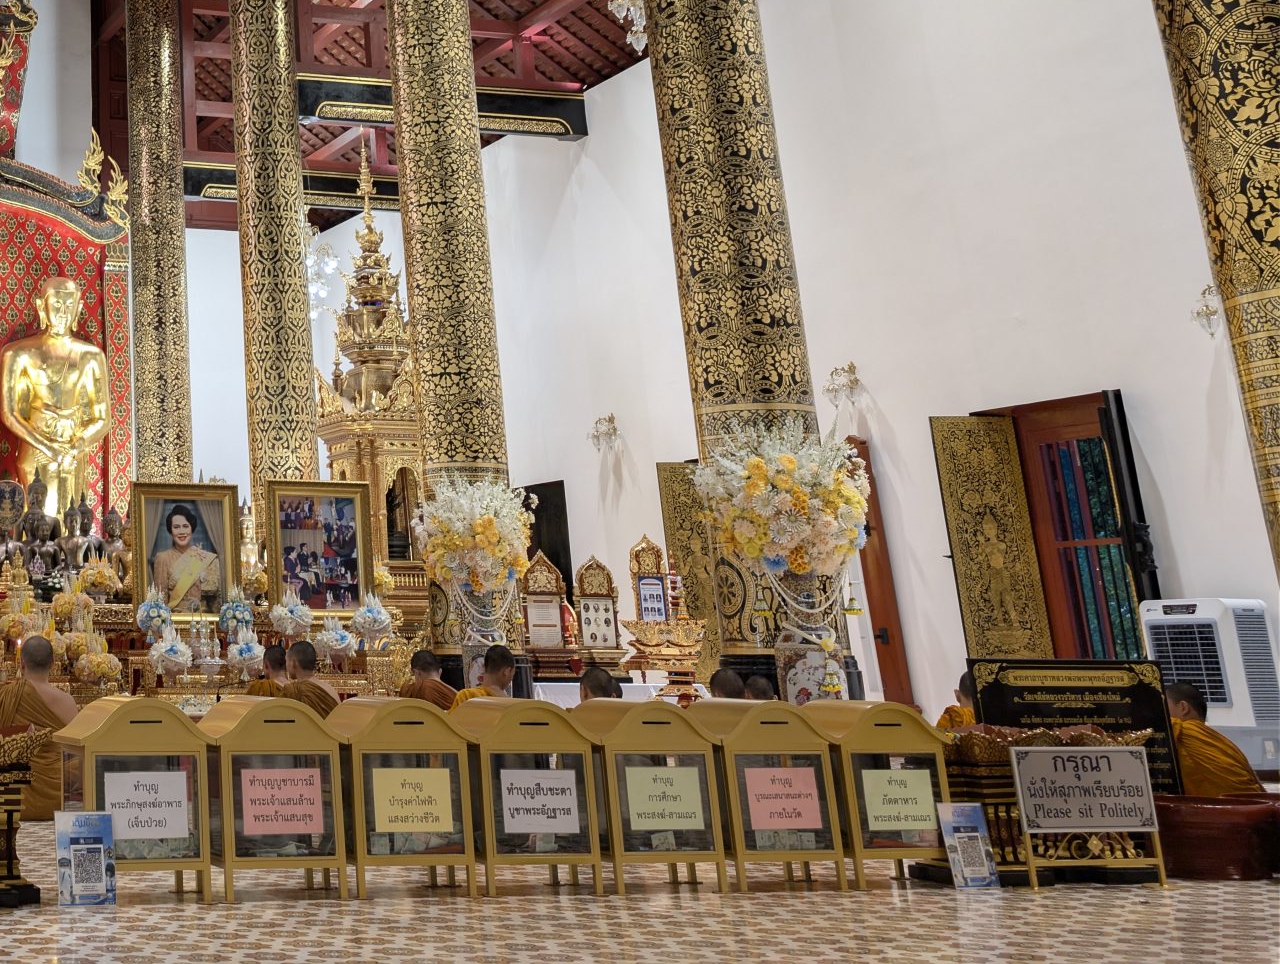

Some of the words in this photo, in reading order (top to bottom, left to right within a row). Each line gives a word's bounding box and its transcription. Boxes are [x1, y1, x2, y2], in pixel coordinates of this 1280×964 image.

[1051, 754, 1113, 781] กรุณา
[133, 780, 159, 794] ทำบุญ
[249, 774, 315, 790] ทำบุญบูชาบารมี
[400, 778, 424, 792] ทำบุญ
[652, 774, 674, 787] ทำบุญ
[770, 775, 793, 788] ทำบุญ
[886, 776, 908, 788] ทำบุญ
[506, 782, 572, 800] ทำบุญสืบชะตา
[648, 791, 682, 802] การศึกษา
[1026, 777, 1144, 804] นั่งให้สุภาพเรียบร้อย
[110, 797, 182, 812] พระภิกษุสงฆ์อาพาธ
[250, 793, 315, 806] พระเจ้าแสนล้าน
[388, 795, 437, 809] บำรุงค่าไฟฟ้า
[253, 810, 314, 826] พระเจ้าแสนสุข
[388, 811, 440, 823] แสงสว่างชีวิต
[508, 803, 571, 819] บูชาพระอัฏฐารส
[769, 807, 803, 819] ภายในวัด
[1033, 804, 1072, 819] Please
[1078, 804, 1093, 818] sit
[1100, 803, 1144, 821] Politely
[127, 815, 167, 828] (เจ็บป่วย)
